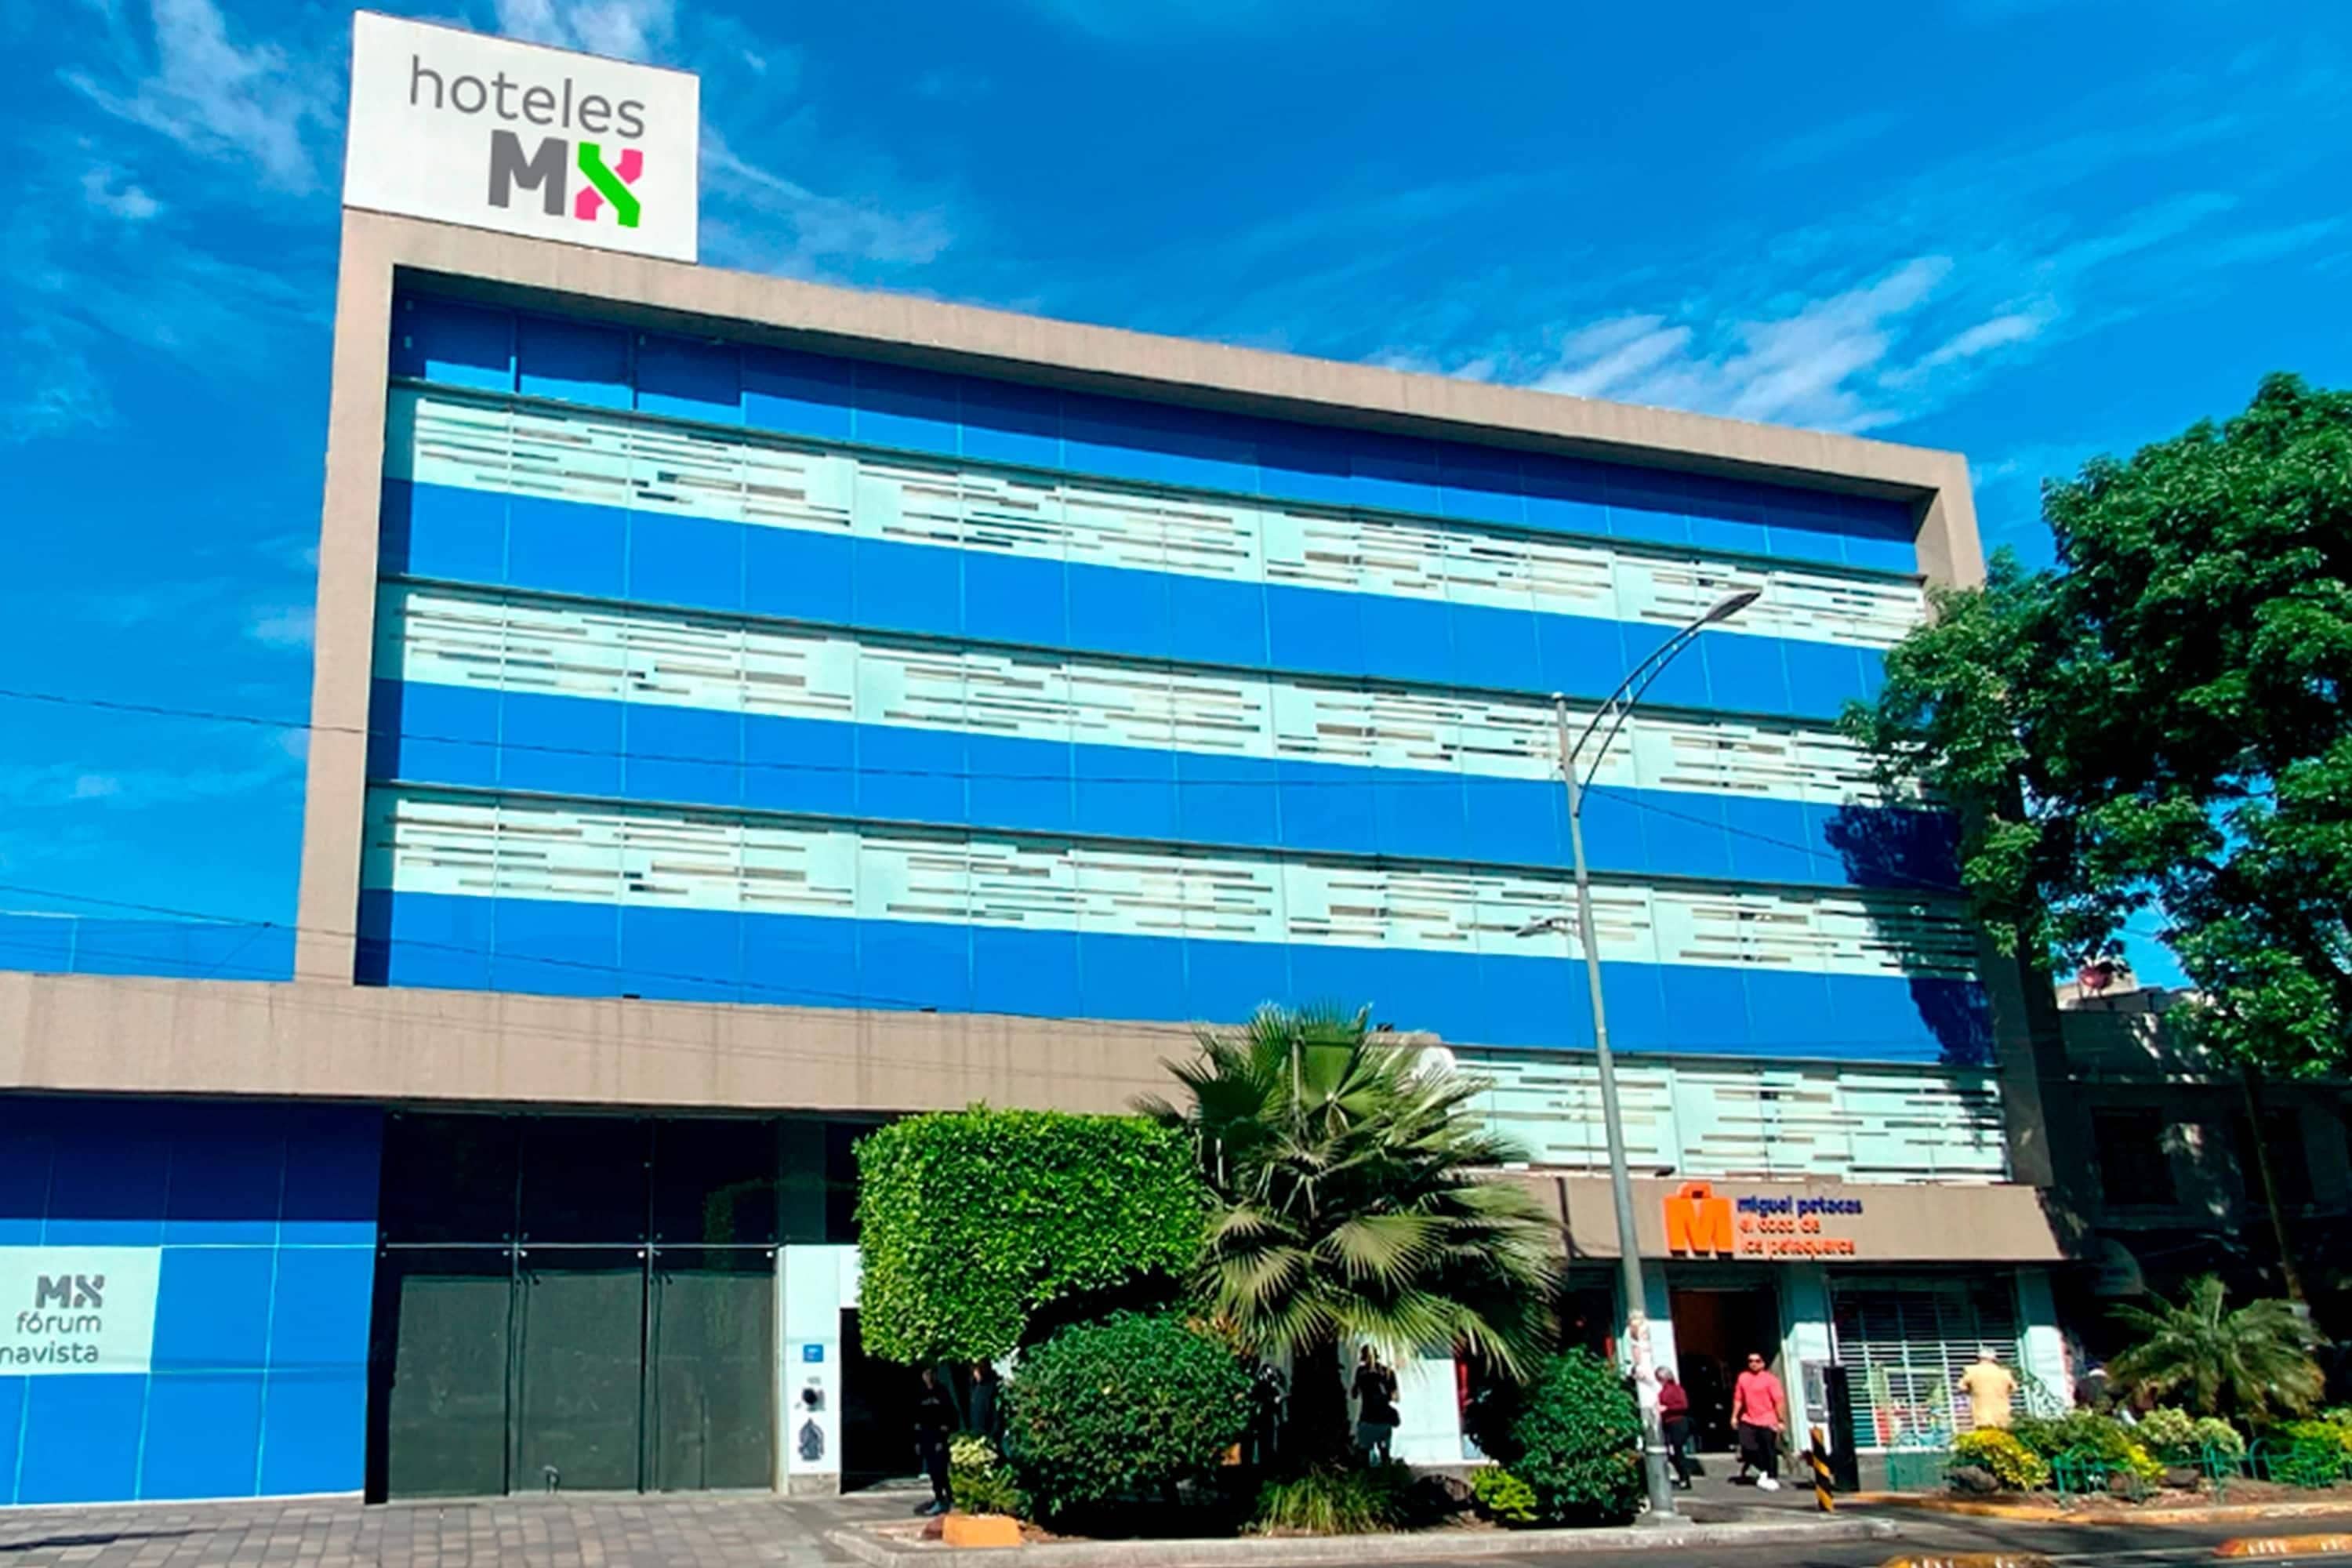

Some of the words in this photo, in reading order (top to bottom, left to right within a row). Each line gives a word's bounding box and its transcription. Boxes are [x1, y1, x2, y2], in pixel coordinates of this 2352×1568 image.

[410, 54, 645, 139] hoteles
[488, 129, 644, 228] MX
[1737, 1195, 1793, 1219] miguel
[1797, 1196, 1864, 1219] petacas
[35, 1274, 105, 1308] MX
[16, 1310, 102, 1334] fórum
[0, 1340, 100, 1365] navista
